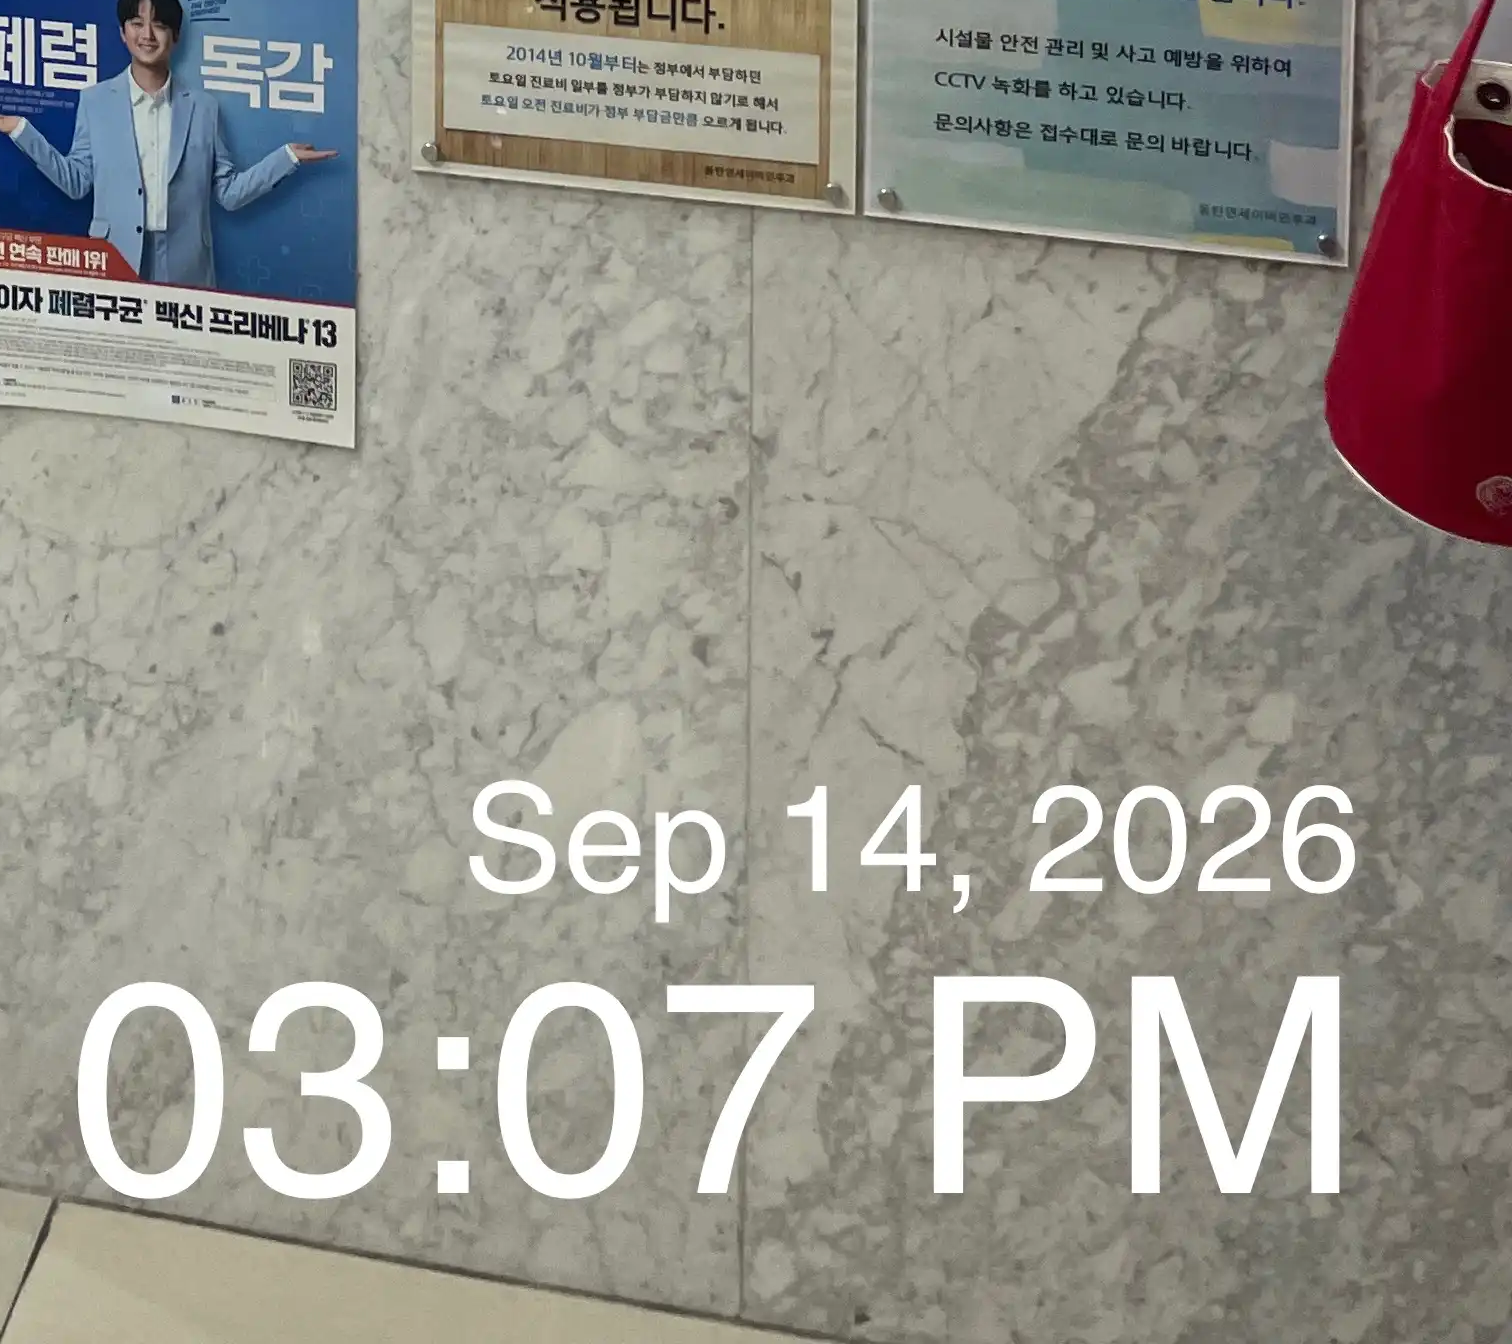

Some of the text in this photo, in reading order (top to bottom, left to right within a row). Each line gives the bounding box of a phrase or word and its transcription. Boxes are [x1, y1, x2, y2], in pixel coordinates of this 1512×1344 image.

[507, 45, 563, 67] 2014년
[569, 51, 649, 75] 10월부터는
[654, 62, 705, 79] 정부에서
[936, 29, 1292, 77] 시설물 안전 관리 및 사고 예방을 위하여
[200, 35, 334, 114] 독감
[489, 71, 779, 112] 토요일 진료비 일부를 정부가 부담하지 않기로 해서
[934, 72, 1192, 111] CCTV 녹화를 하고 있습니다.
[481, 93, 787, 136] 토요일 오전 진료비가 정부 부담금만큼 오르게 됩니다.
[933, 113, 1259, 162] 문의사항은 접수대로 문의 바랍니다.
[8, 242, 42, 264] 연속
[46, 246, 80, 268] 판매
[155, 300, 203, 332] 백신
